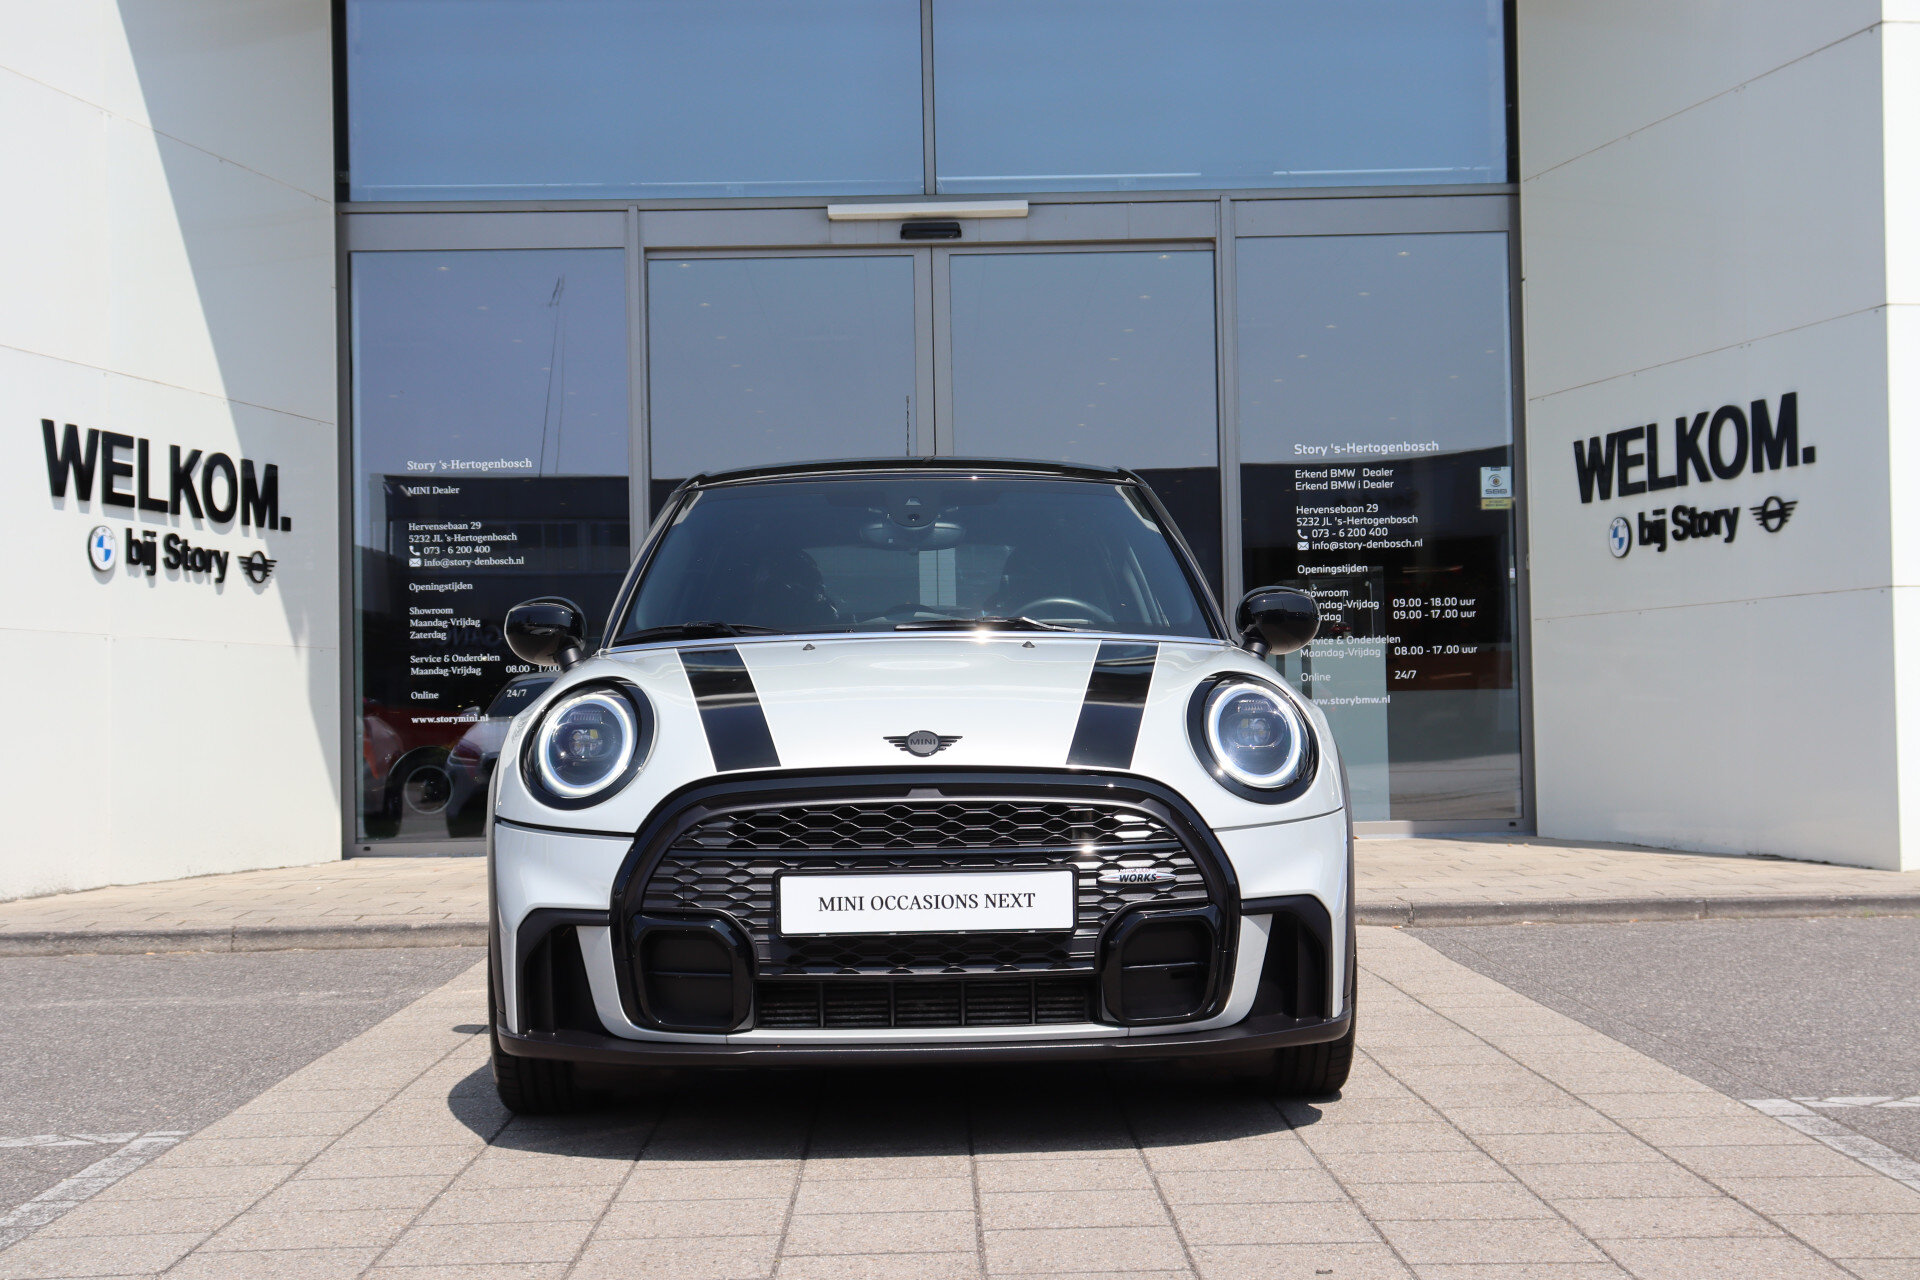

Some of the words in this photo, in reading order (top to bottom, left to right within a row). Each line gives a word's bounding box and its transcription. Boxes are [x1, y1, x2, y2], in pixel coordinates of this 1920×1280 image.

[1294, 443, 1327, 457] Story
[1330, 440, 1440, 455] 's-Hertogenbosch
[1573, 391, 1816, 504] WELKOM.
[407, 460, 436, 472] Story
[41, 418, 292, 532] WELKOM.
[1295, 469, 1328, 479] Erkend
[1330, 468, 1356, 478] BMW
[1363, 467, 1394, 477] Dealer
[407, 486, 430, 495] MINI
[432, 486, 460, 494] Dealer
[1295, 481, 1328, 491] Erkend
[1331, 480, 1356, 490] BMW
[1363, 479, 1394, 489] Dealer
[1296, 505, 1364, 515] Hervensebaan
[1366, 504, 1379, 513] 29
[408, 522, 468, 531] Hervensebaan
[470, 522, 481, 530] 29
[1296, 517, 1320, 527] 5232
[1322, 517, 1332, 526] JL
[1334, 515, 1418, 526] 's-Hertogenbosch
[1312, 529, 1330, 538] 073
[1338, 528, 1345, 537] 6
[1347, 528, 1366, 537] 200
[1368, 527, 1388, 537] 400
[1638, 508, 1667, 552] bij
[1671, 505, 1740, 543] Story
[408, 535, 430, 543] 5232
[432, 534, 443, 542] JL
[424, 546, 440, 554] 073
[447, 546, 454, 554] 6
[455, 545, 472, 554] 200
[473, 545, 491, 553] 400
[1312, 538, 1423, 552] info@story-denbosch.nl
[125, 527, 157, 576] bij
[163, 533, 229, 583] Story
[424, 557, 524, 568] info@story-denbosch.nl
[1297, 564, 1368, 575] Openingstijden
[409, 582, 473, 593] Openingstijden
[1393, 598, 1422, 608] 09.00
[1430, 597, 1457, 607] 18.00
[1459, 598, 1476, 606] uur
[409, 607, 454, 615] Showroom
[1393, 610, 1422, 620] 09.00
[1460, 610, 1477, 618] uur
[409, 618, 481, 628] Maandag-Vrijdag
[410, 631, 447, 640] Zaterdag
[1336, 637, 1344, 645] &
[1346, 634, 1401, 645] Onderdelen
[1300, 648, 1381, 658] Maandag-Vrijdag
[1394, 646, 1424, 656] 08.00
[1461, 646, 1478, 654] uur
[410, 655, 442, 664] Service
[443, 655, 450, 663] &
[451, 653, 500, 663] Onderdelen
[410, 666, 482, 676] Maandag-Vrijdag
[505, 665, 530, 673] 08.00
[1300, 673, 1332, 682] Online
[1394, 670, 1417, 680] 24/7
[411, 691, 439, 700] Online
[506, 689, 527, 698] 24/7
[411, 713, 489, 724] www.storymini.nl
[1119, 873, 1158, 882] WORKS
[818, 896, 864, 911] MINI
[870, 893, 979, 911] OCCASIONS
[984, 893, 1036, 909] NEXT
